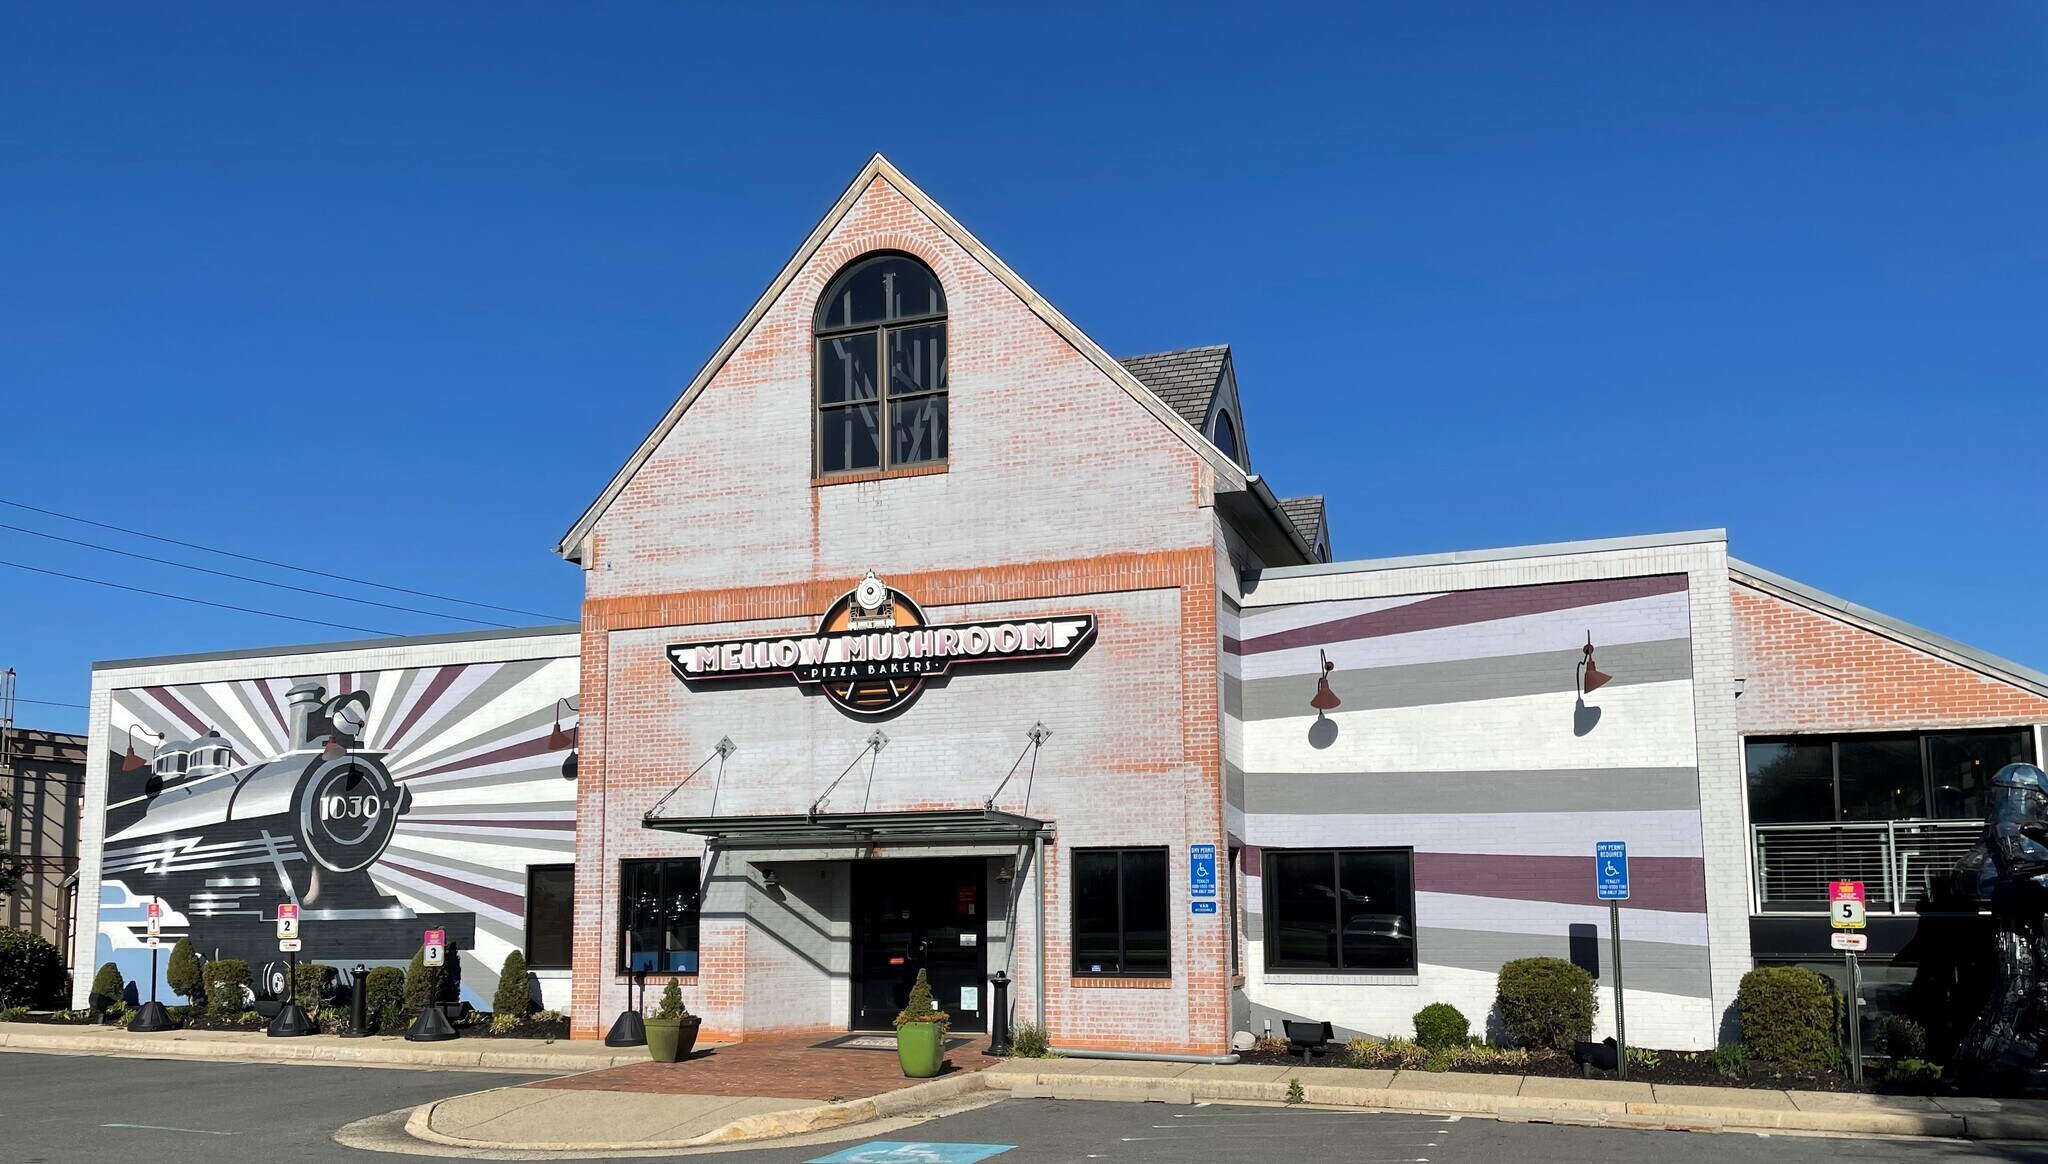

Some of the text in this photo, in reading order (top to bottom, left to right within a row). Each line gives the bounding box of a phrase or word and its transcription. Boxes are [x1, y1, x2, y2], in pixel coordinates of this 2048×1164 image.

[695, 621, 1055, 672] MELLOW MUSHROOM
[811, 661, 930, 677] PIZZA BAKERS
[320, 795, 380, 820] 1030
[1842, 904, 1853, 918] 5
[152, 919, 156, 929] 1
[284, 920, 291, 931] 2
[430, 947, 437, 958] 3
